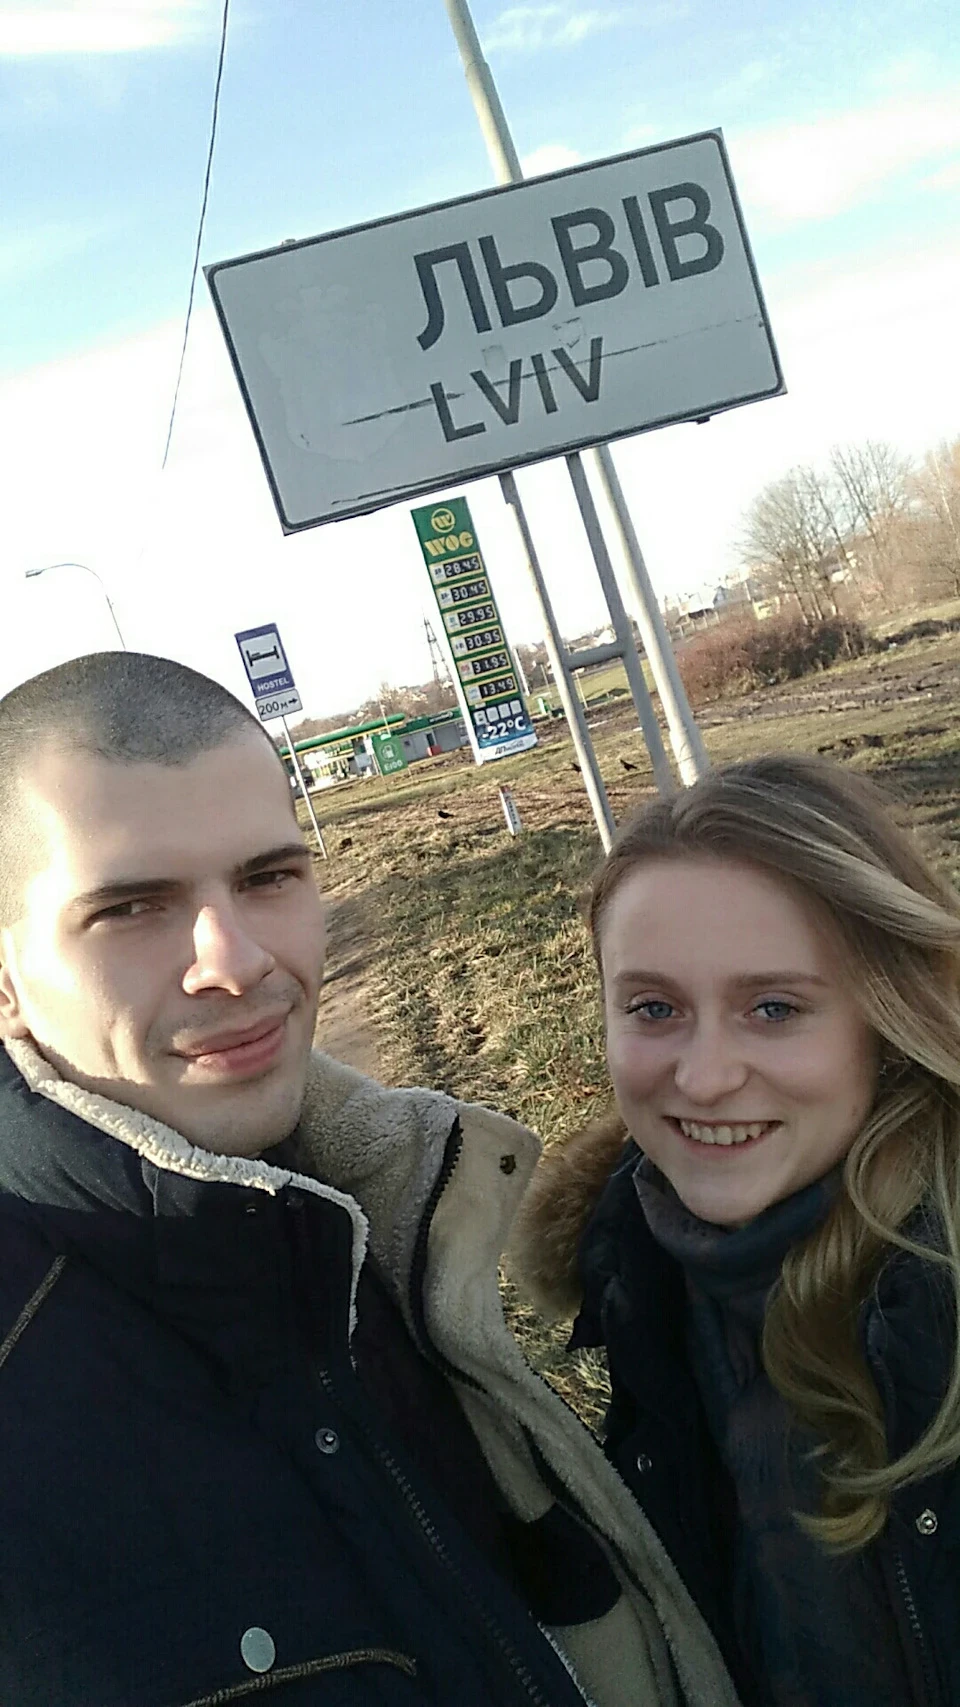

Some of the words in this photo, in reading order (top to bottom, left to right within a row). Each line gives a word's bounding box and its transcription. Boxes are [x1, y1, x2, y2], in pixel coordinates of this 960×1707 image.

[414, 181, 725, 351] ЛЬВІВ
[429, 336, 604, 443] LVIV
[424, 531, 474, 557] WOG
[444, 557, 480, 576] 28.45
[452, 582, 487, 600] 30.45
[460, 606, 494, 625] 29.95
[466, 630, 501, 649] 30.95
[256, 677, 290, 692] HOSTEL
[483, 678, 514, 695] 13.49
[259, 701, 280, 716] 200
